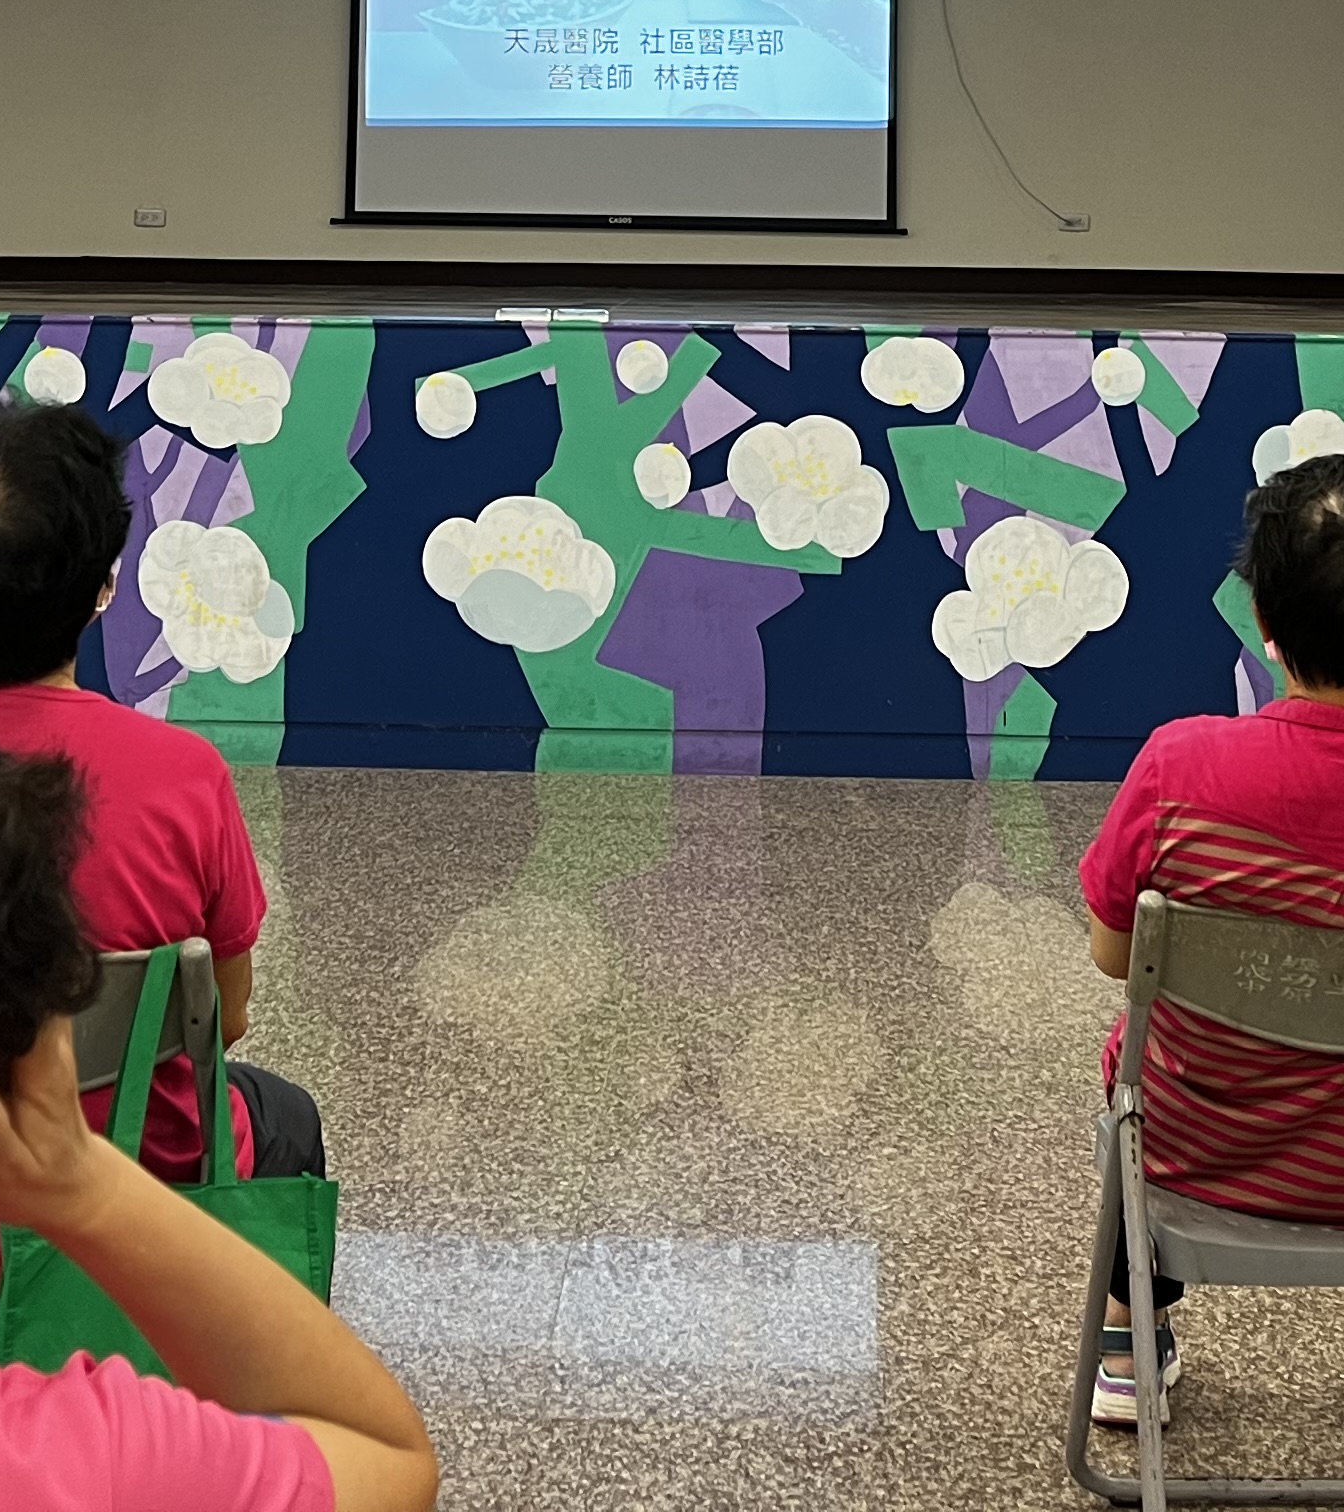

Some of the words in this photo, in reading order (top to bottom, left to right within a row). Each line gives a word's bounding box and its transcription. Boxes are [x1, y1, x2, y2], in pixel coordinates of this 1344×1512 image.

[504, 28, 619, 55] 天晟醫院
[639, 28, 784, 56] 社區醫學部
[547, 63, 633, 91] 營養師
[654, 63, 740, 91] 林詩蓓
